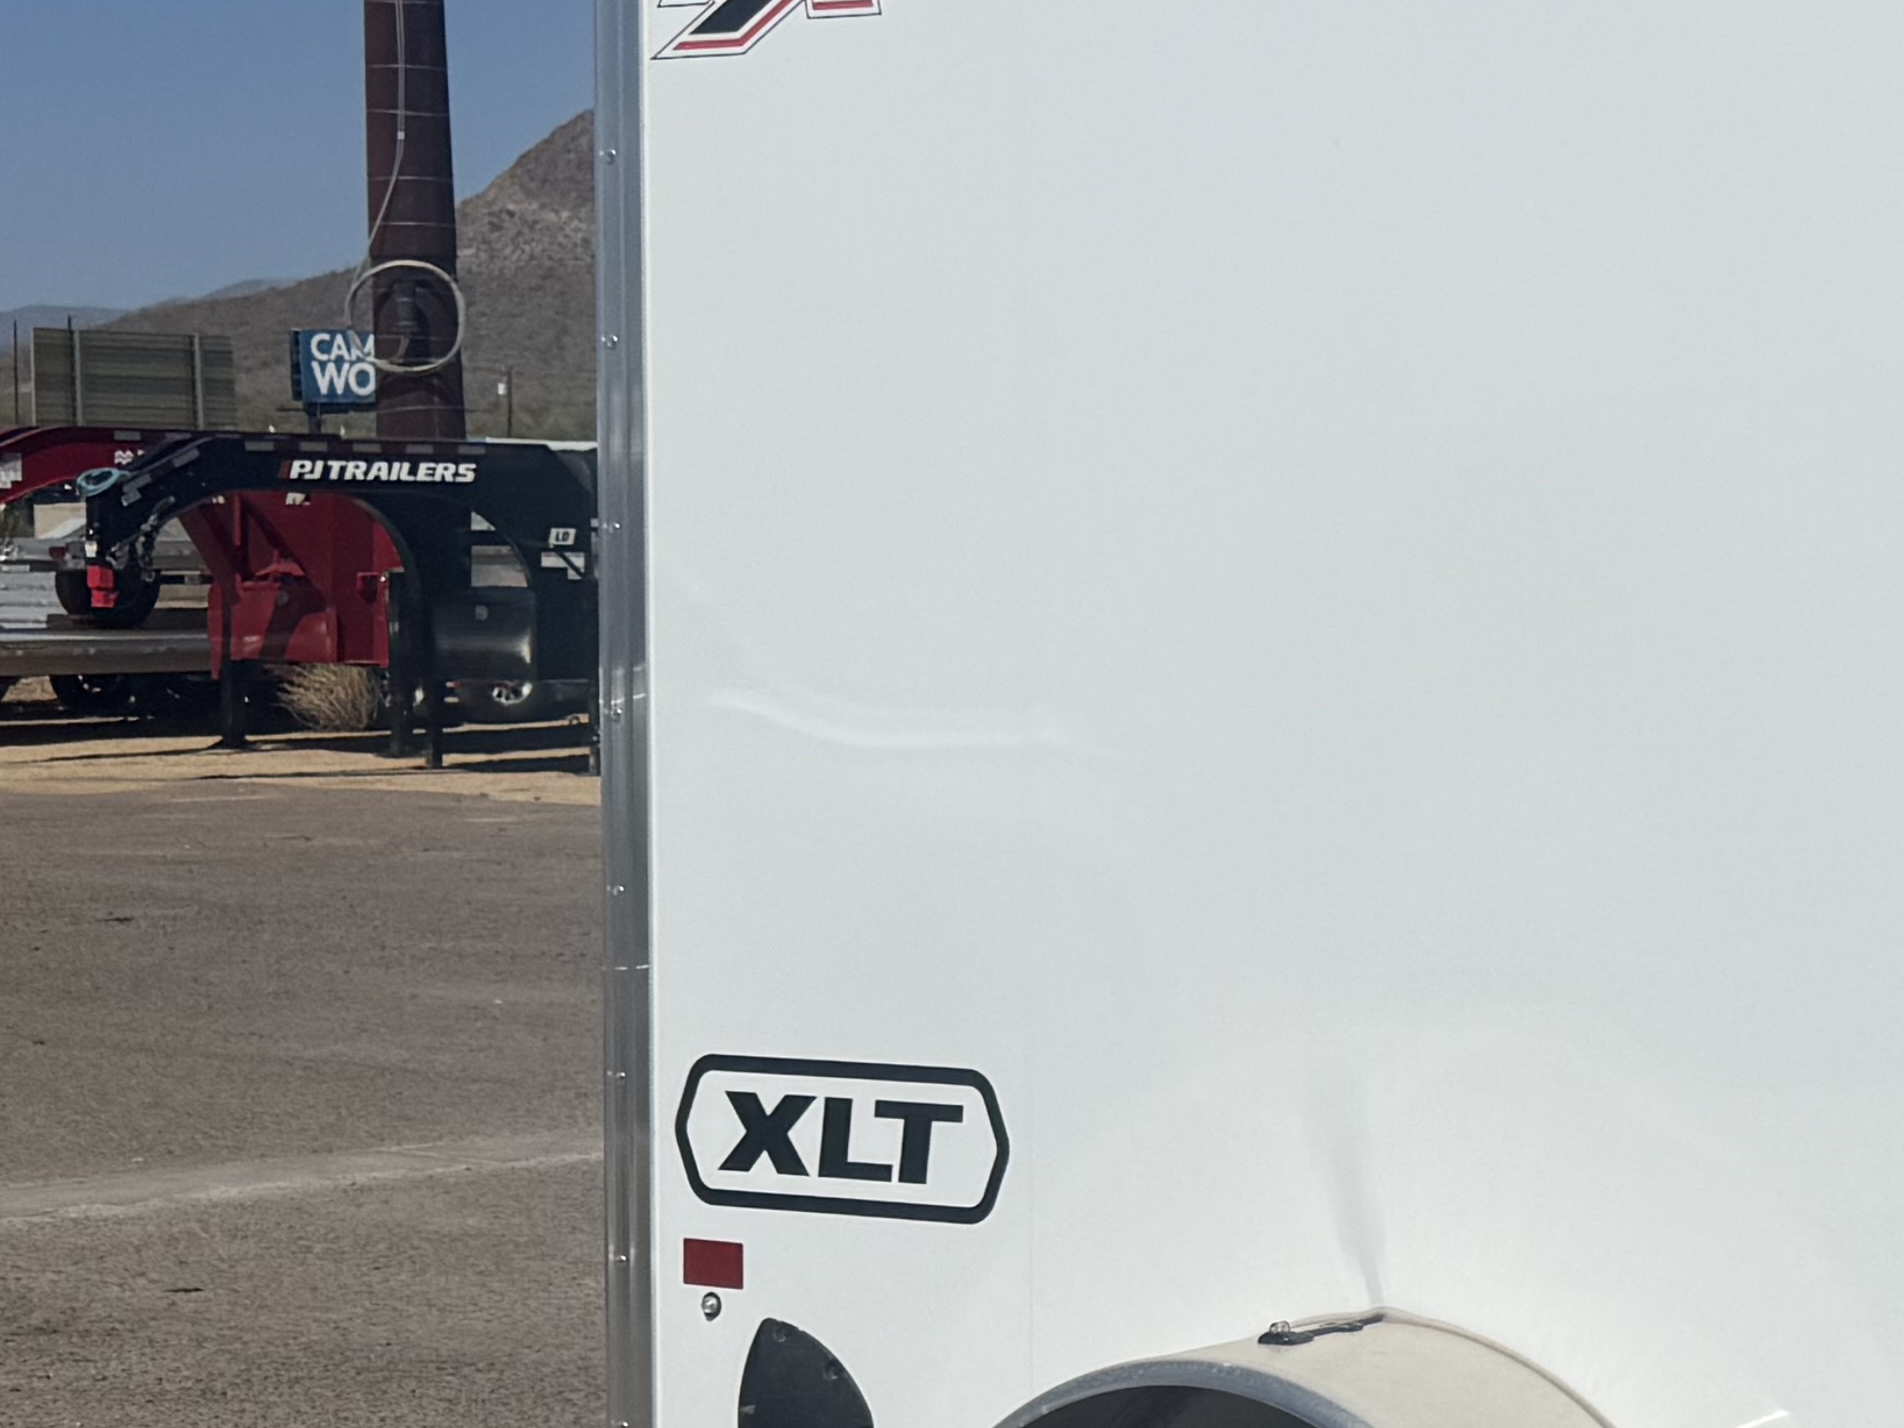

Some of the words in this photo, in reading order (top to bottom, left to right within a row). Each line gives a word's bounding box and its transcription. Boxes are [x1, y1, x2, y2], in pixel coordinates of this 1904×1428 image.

[311, 361, 377, 396] WO
[289, 459, 325, 480] PJ
[327, 460, 477, 483] TRAILERS
[718, 1090, 964, 1185] XLT
